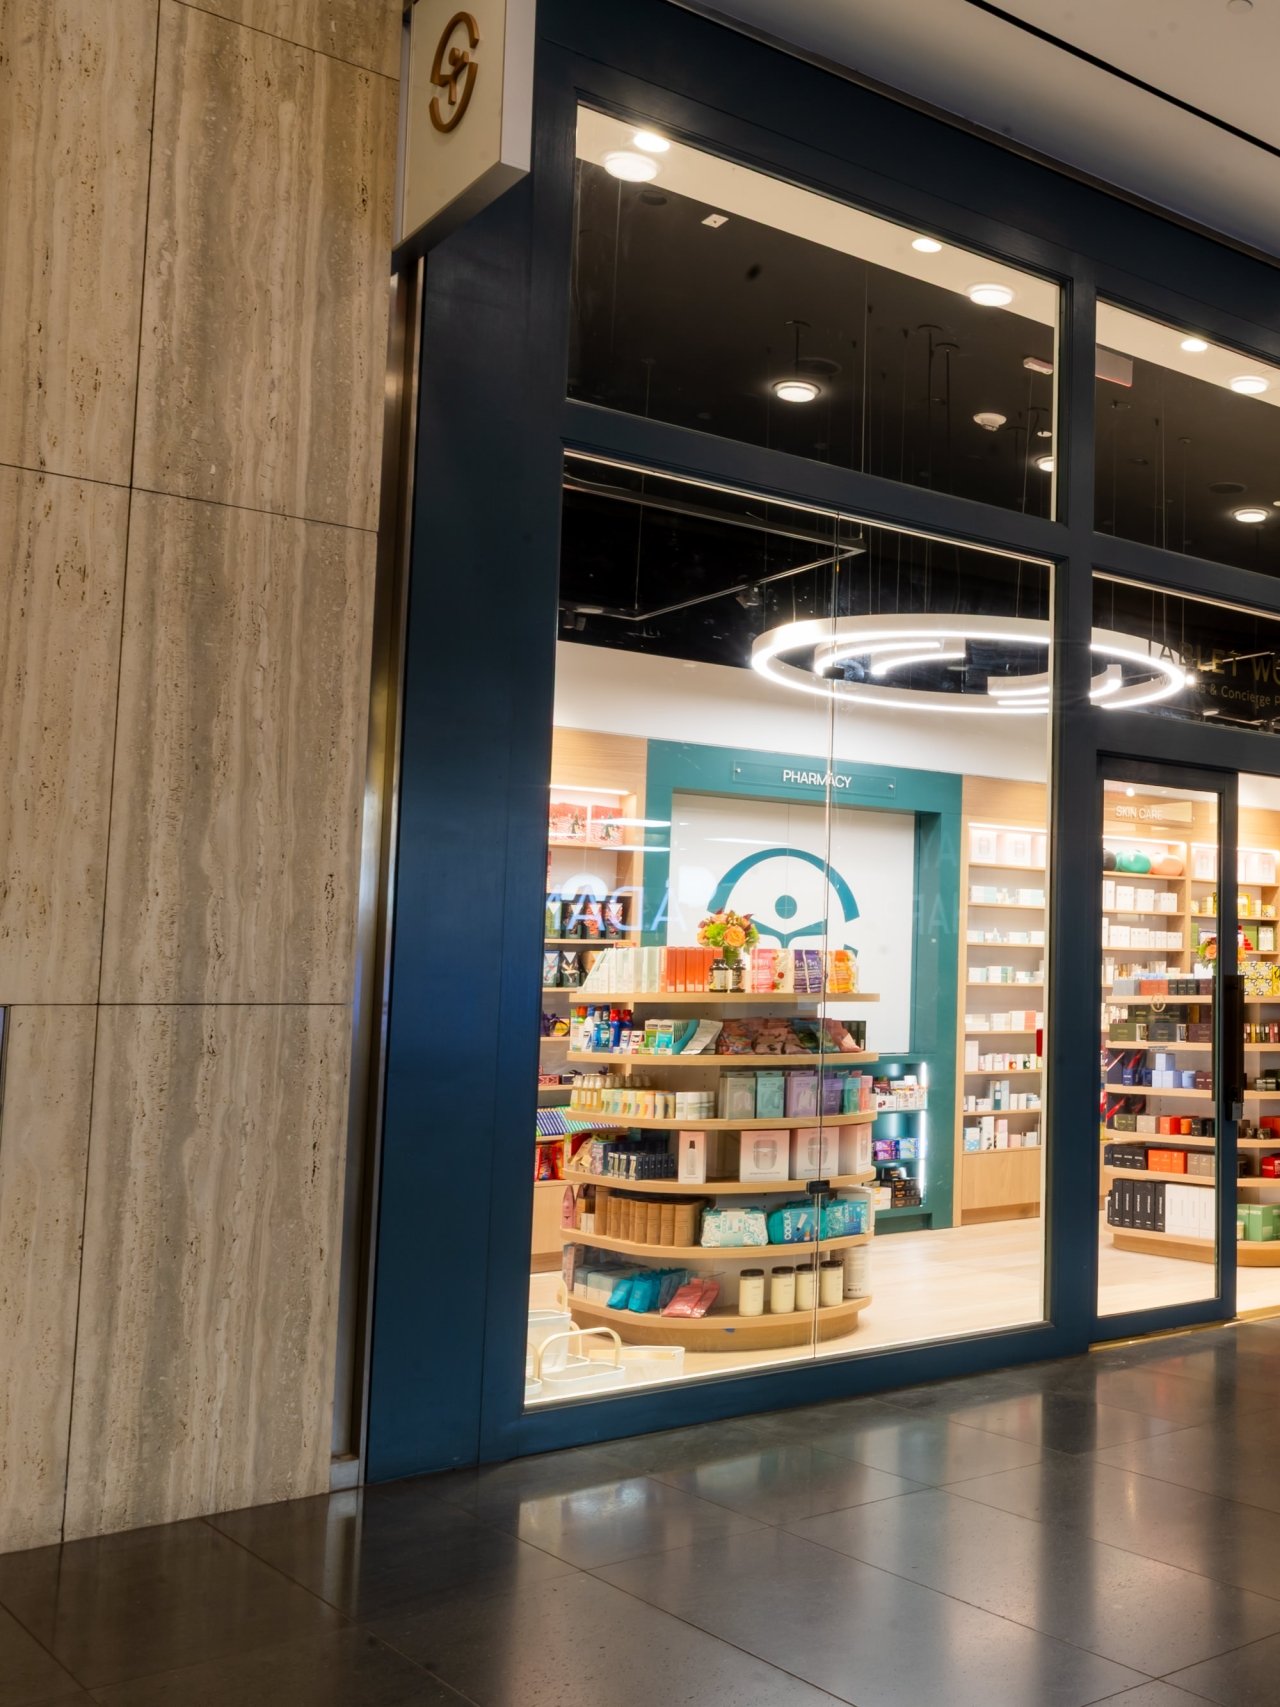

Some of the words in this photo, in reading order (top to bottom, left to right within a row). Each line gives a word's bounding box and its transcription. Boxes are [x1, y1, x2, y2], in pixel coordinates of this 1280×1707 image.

[1221, 684, 1271, 709] Concierge
[783, 769, 852, 788] PHARMACY
[1115, 805, 1137, 818] SKIN
[783, 1211, 792, 1241] COOLA
